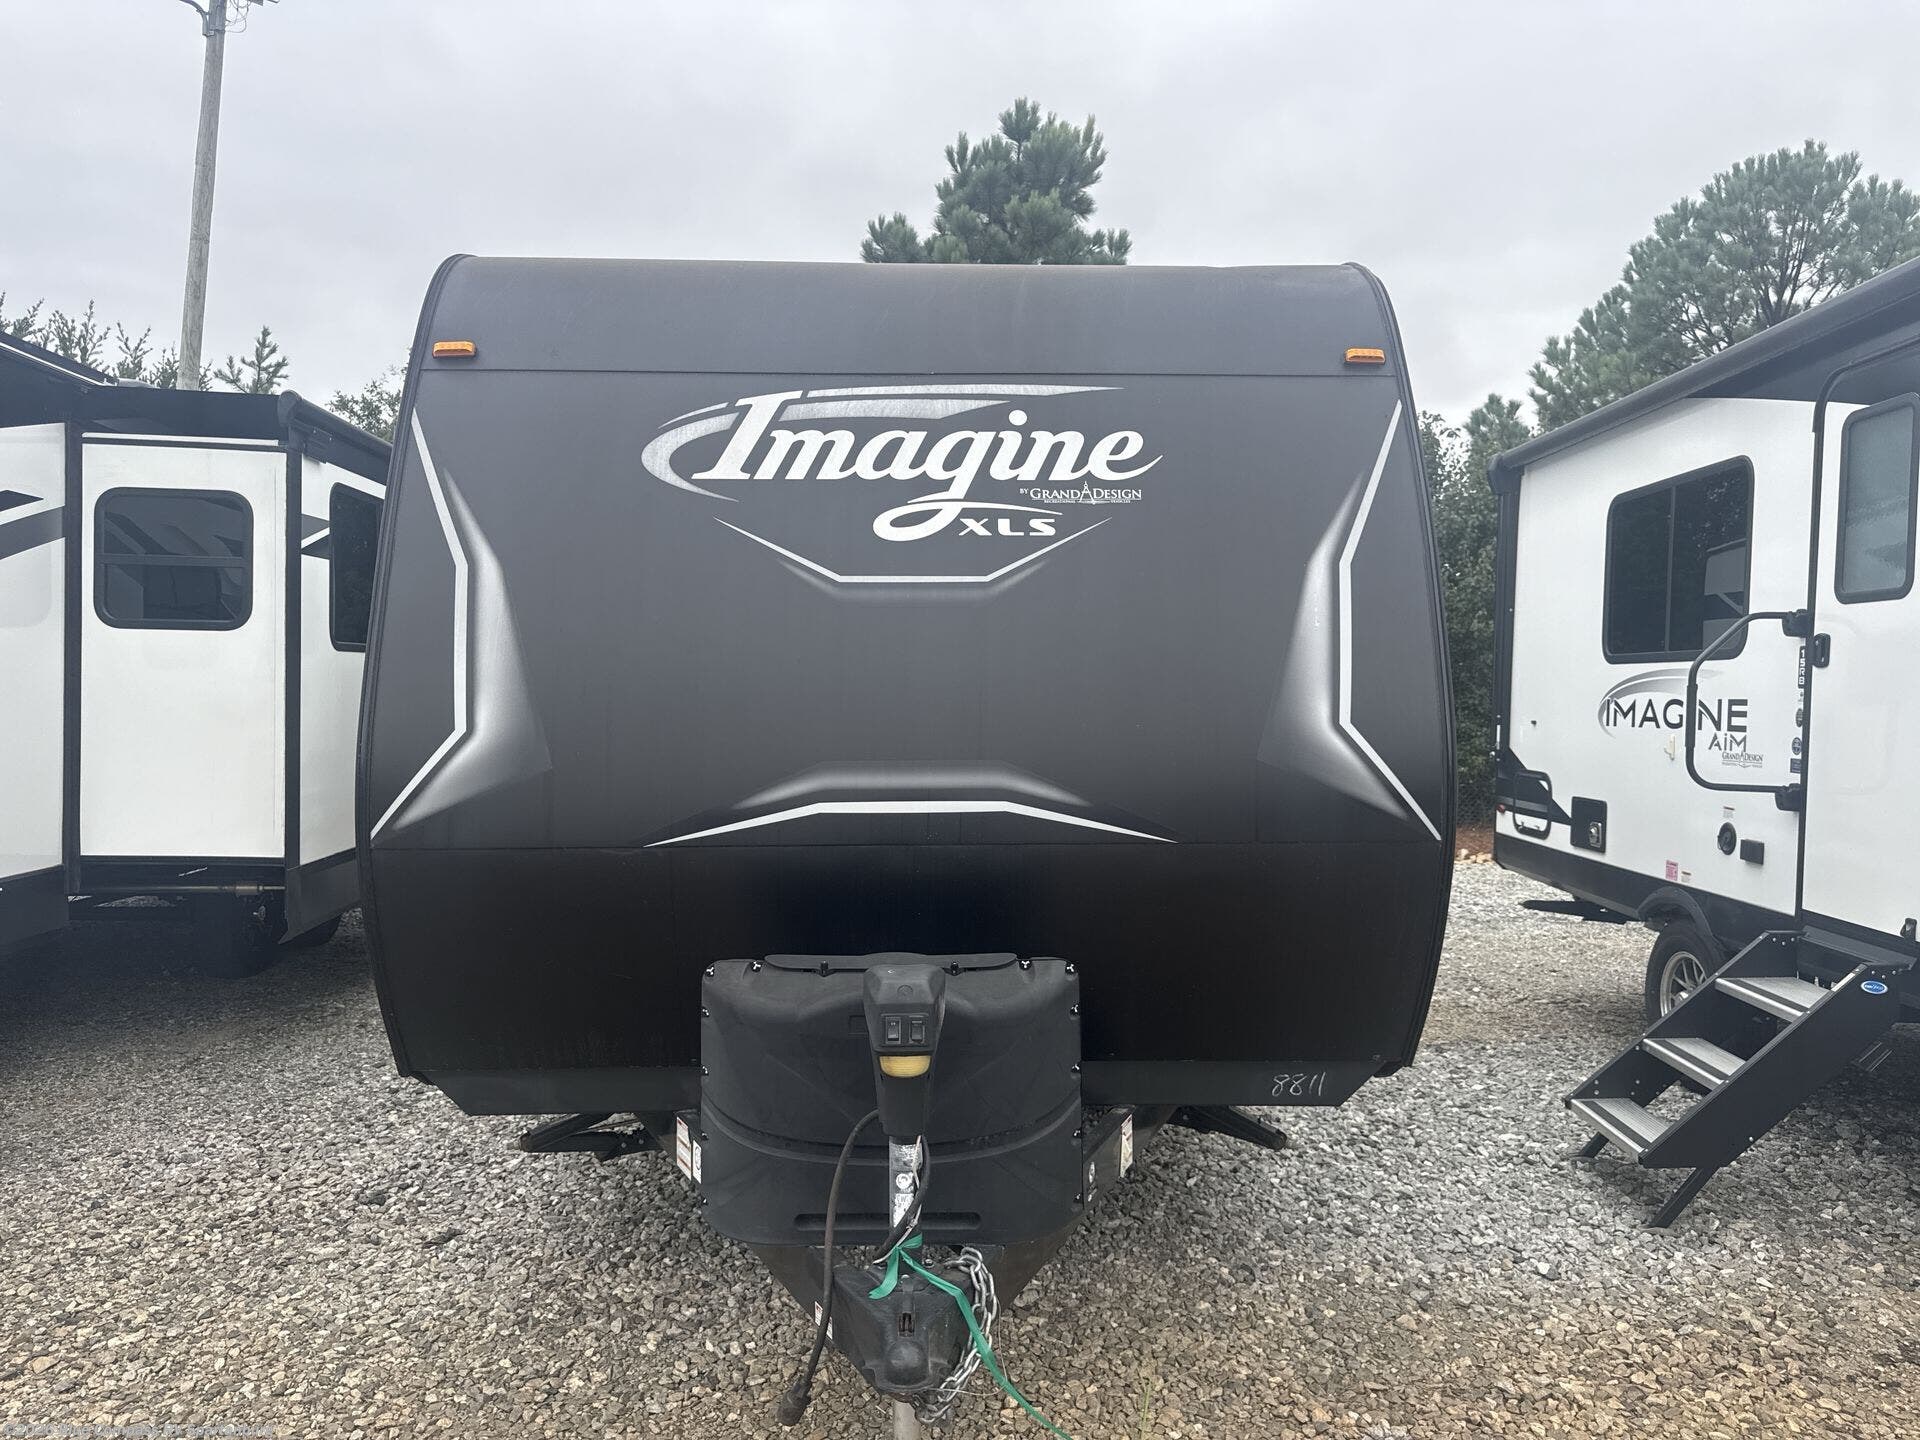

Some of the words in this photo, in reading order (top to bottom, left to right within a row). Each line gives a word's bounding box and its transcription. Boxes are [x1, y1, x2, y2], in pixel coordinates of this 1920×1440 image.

[691, 389, 1164, 542] Imagine
[1030, 488, 1080, 499] GRAND
[1093, 488, 1142, 499] DESIGN
[958, 518, 1057, 537] XLS
[1605, 698, 1749, 733] IMAGNE
[1271, 1071, 1327, 1097] 8811
